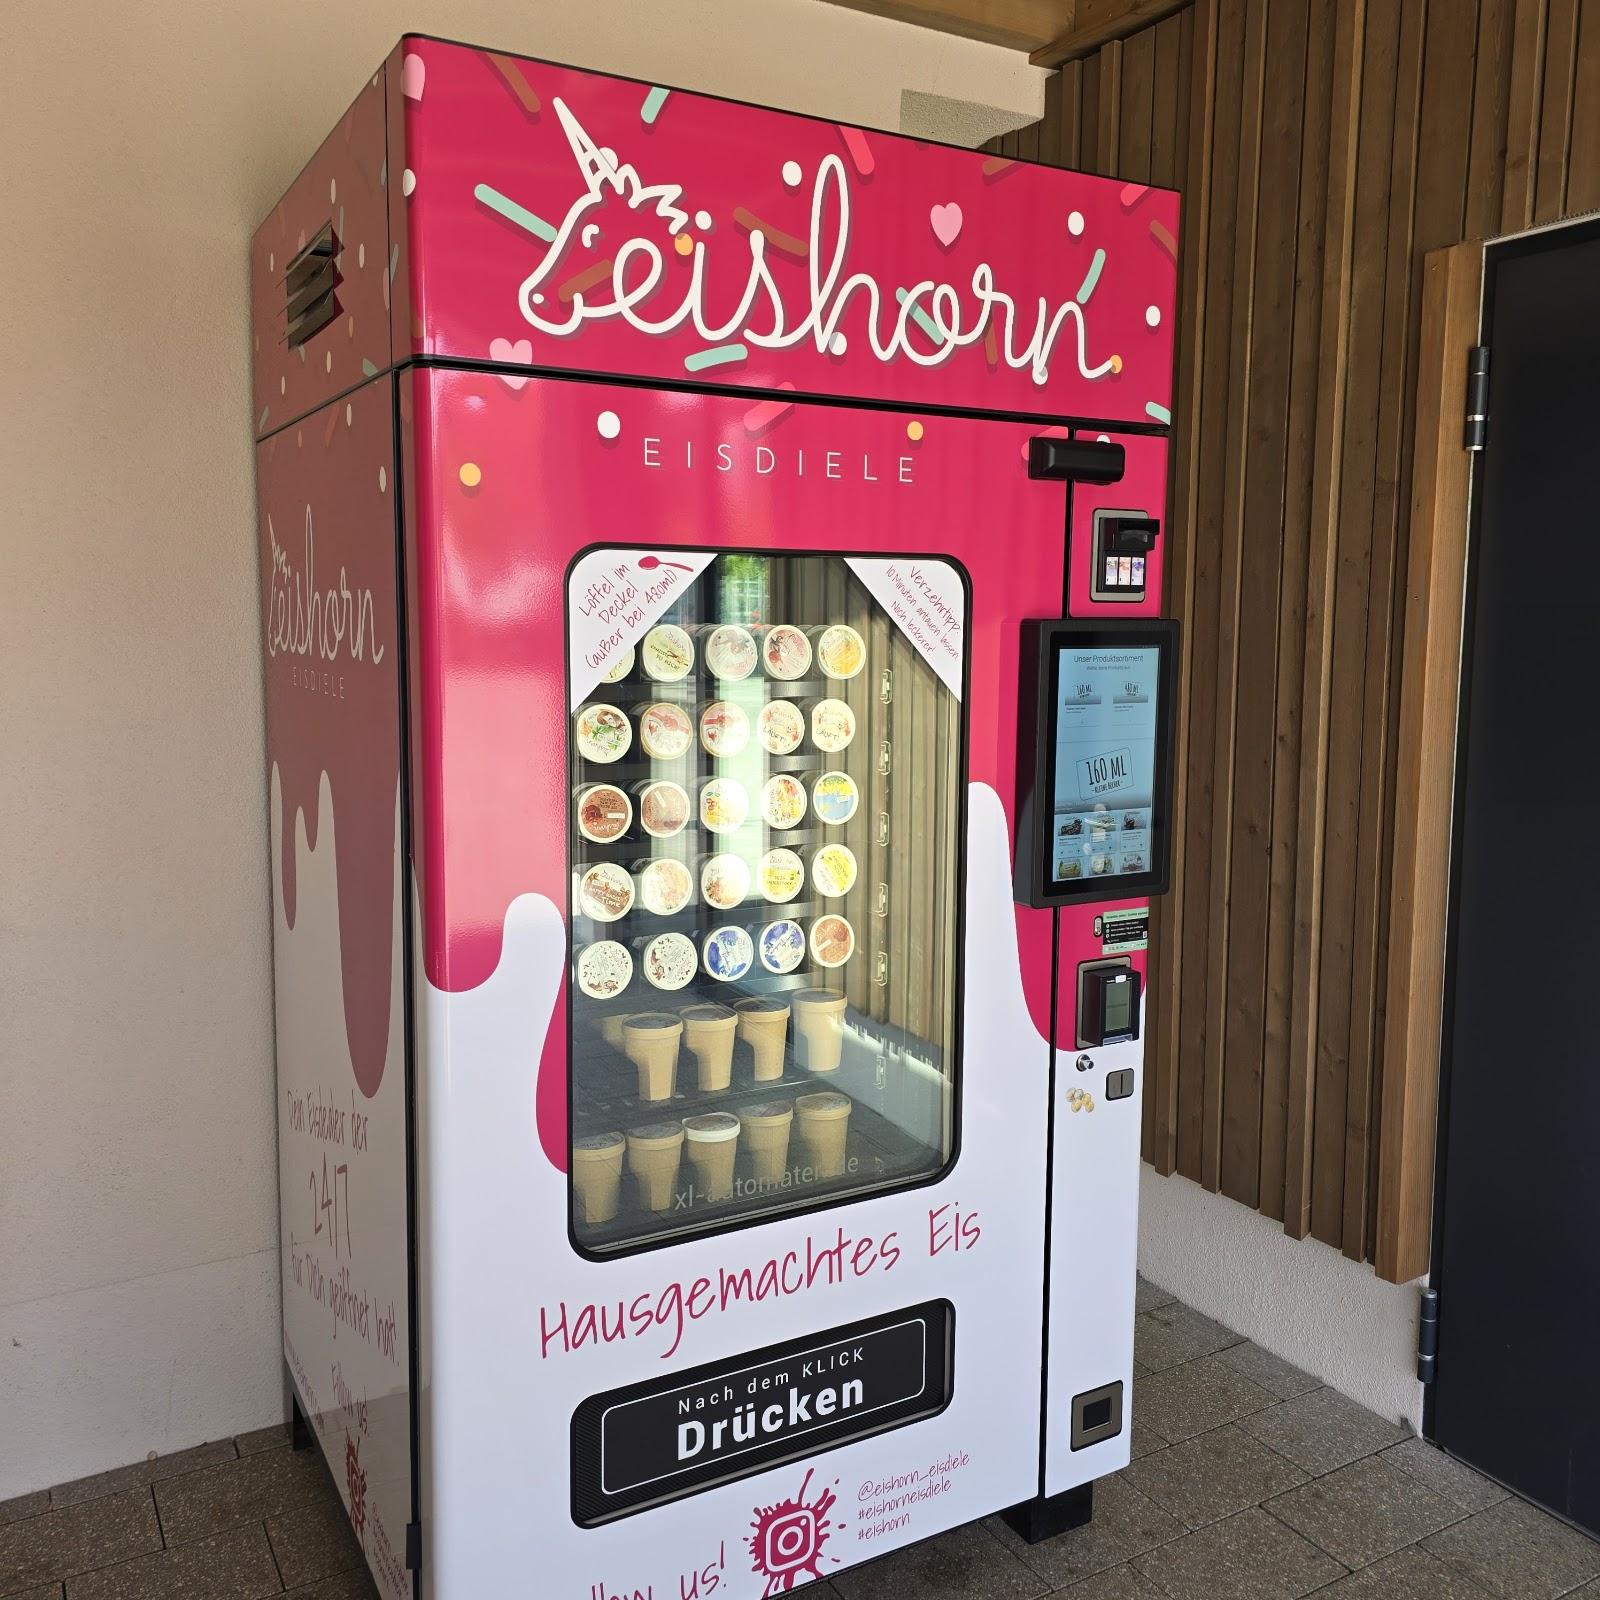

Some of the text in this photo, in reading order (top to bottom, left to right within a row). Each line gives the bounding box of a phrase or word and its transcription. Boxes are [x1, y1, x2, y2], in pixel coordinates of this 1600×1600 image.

[572, 153, 1121, 384] eishorn
[643, 436, 917, 485] EISDIELE
[579, 574, 616, 617] Löffel
[598, 579, 639, 624] Deckel
[621, 604, 646, 628] bei
[644, 568, 678, 604] 480ml)
[886, 564, 960, 660] 10 Minuten antauen lassen
[890, 600, 936, 655] Noch leckerer!
[292, 666, 345, 699] EISDIELE
[1073, 654, 1145, 664] Unser Produktsortiment
[1086, 755, 1128, 786] 160 ML
[287, 1088, 305, 1132] Dein
[351, 1088, 369, 1155] der
[539, 1201, 982, 1359] Hausgemachtes Eis
[678, 1347, 865, 1415] Nach dem KLICK
[677, 1377, 865, 1461] Drücken
[857, 1450, 970, 1502] @eishorn_eisdiele
[857, 1475, 953, 1520] #eishorneisdiele
[857, 1512, 911, 1541] #eishorn
[680, 1540, 728, 1600] us!
